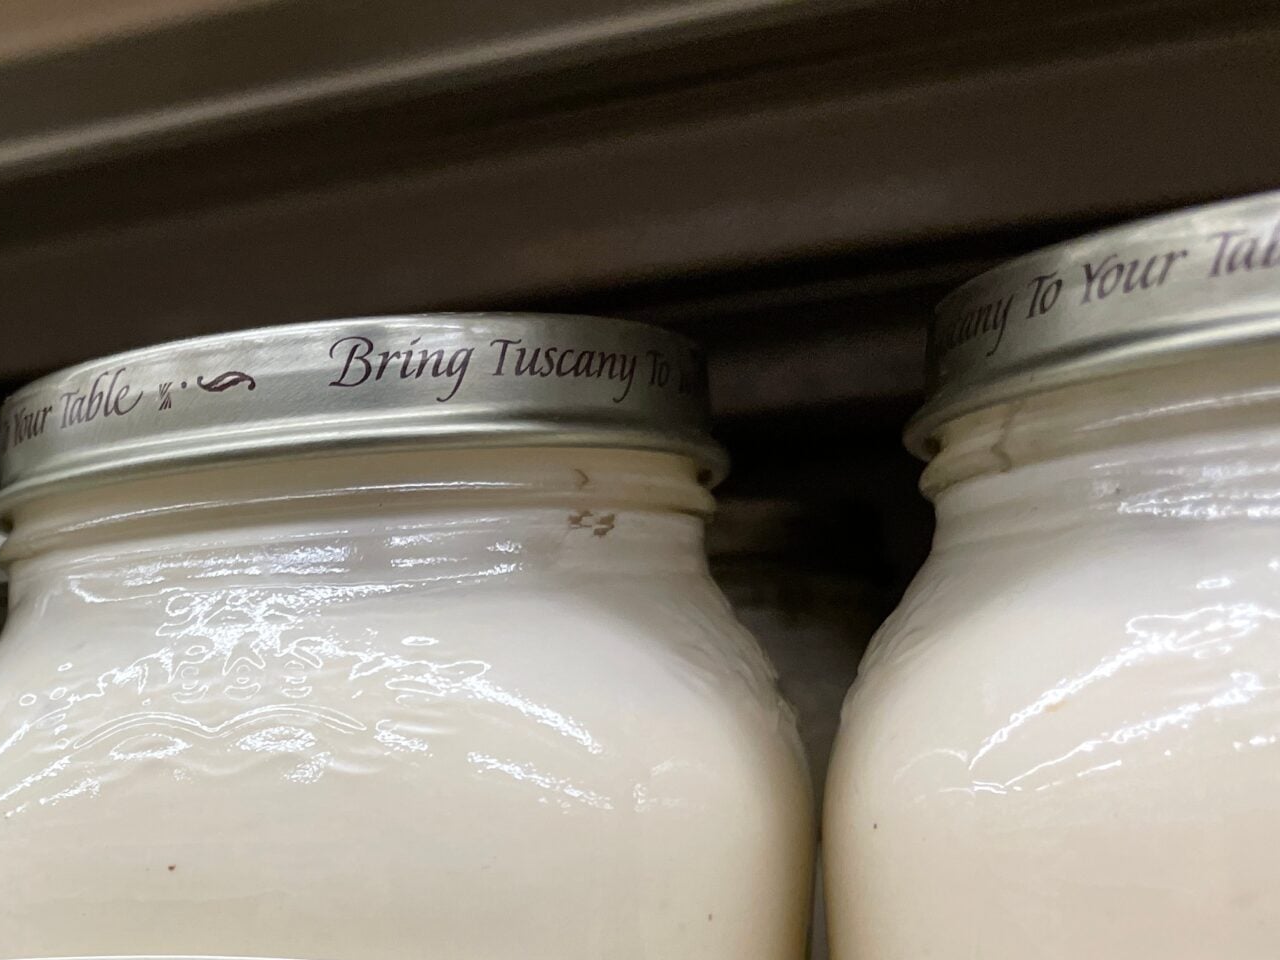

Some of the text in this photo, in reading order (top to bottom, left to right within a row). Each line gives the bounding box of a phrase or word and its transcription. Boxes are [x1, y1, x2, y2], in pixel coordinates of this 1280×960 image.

[1026, 271, 1063, 320] To
[1080, 248, 1188, 305] Your
[328, 335, 474, 403] Bring
[491, 337, 638, 404] Tuscany
[646, 350, 671, 388] To
[14, 405, 53, 447] Your
[60, 367, 144, 430] Table
